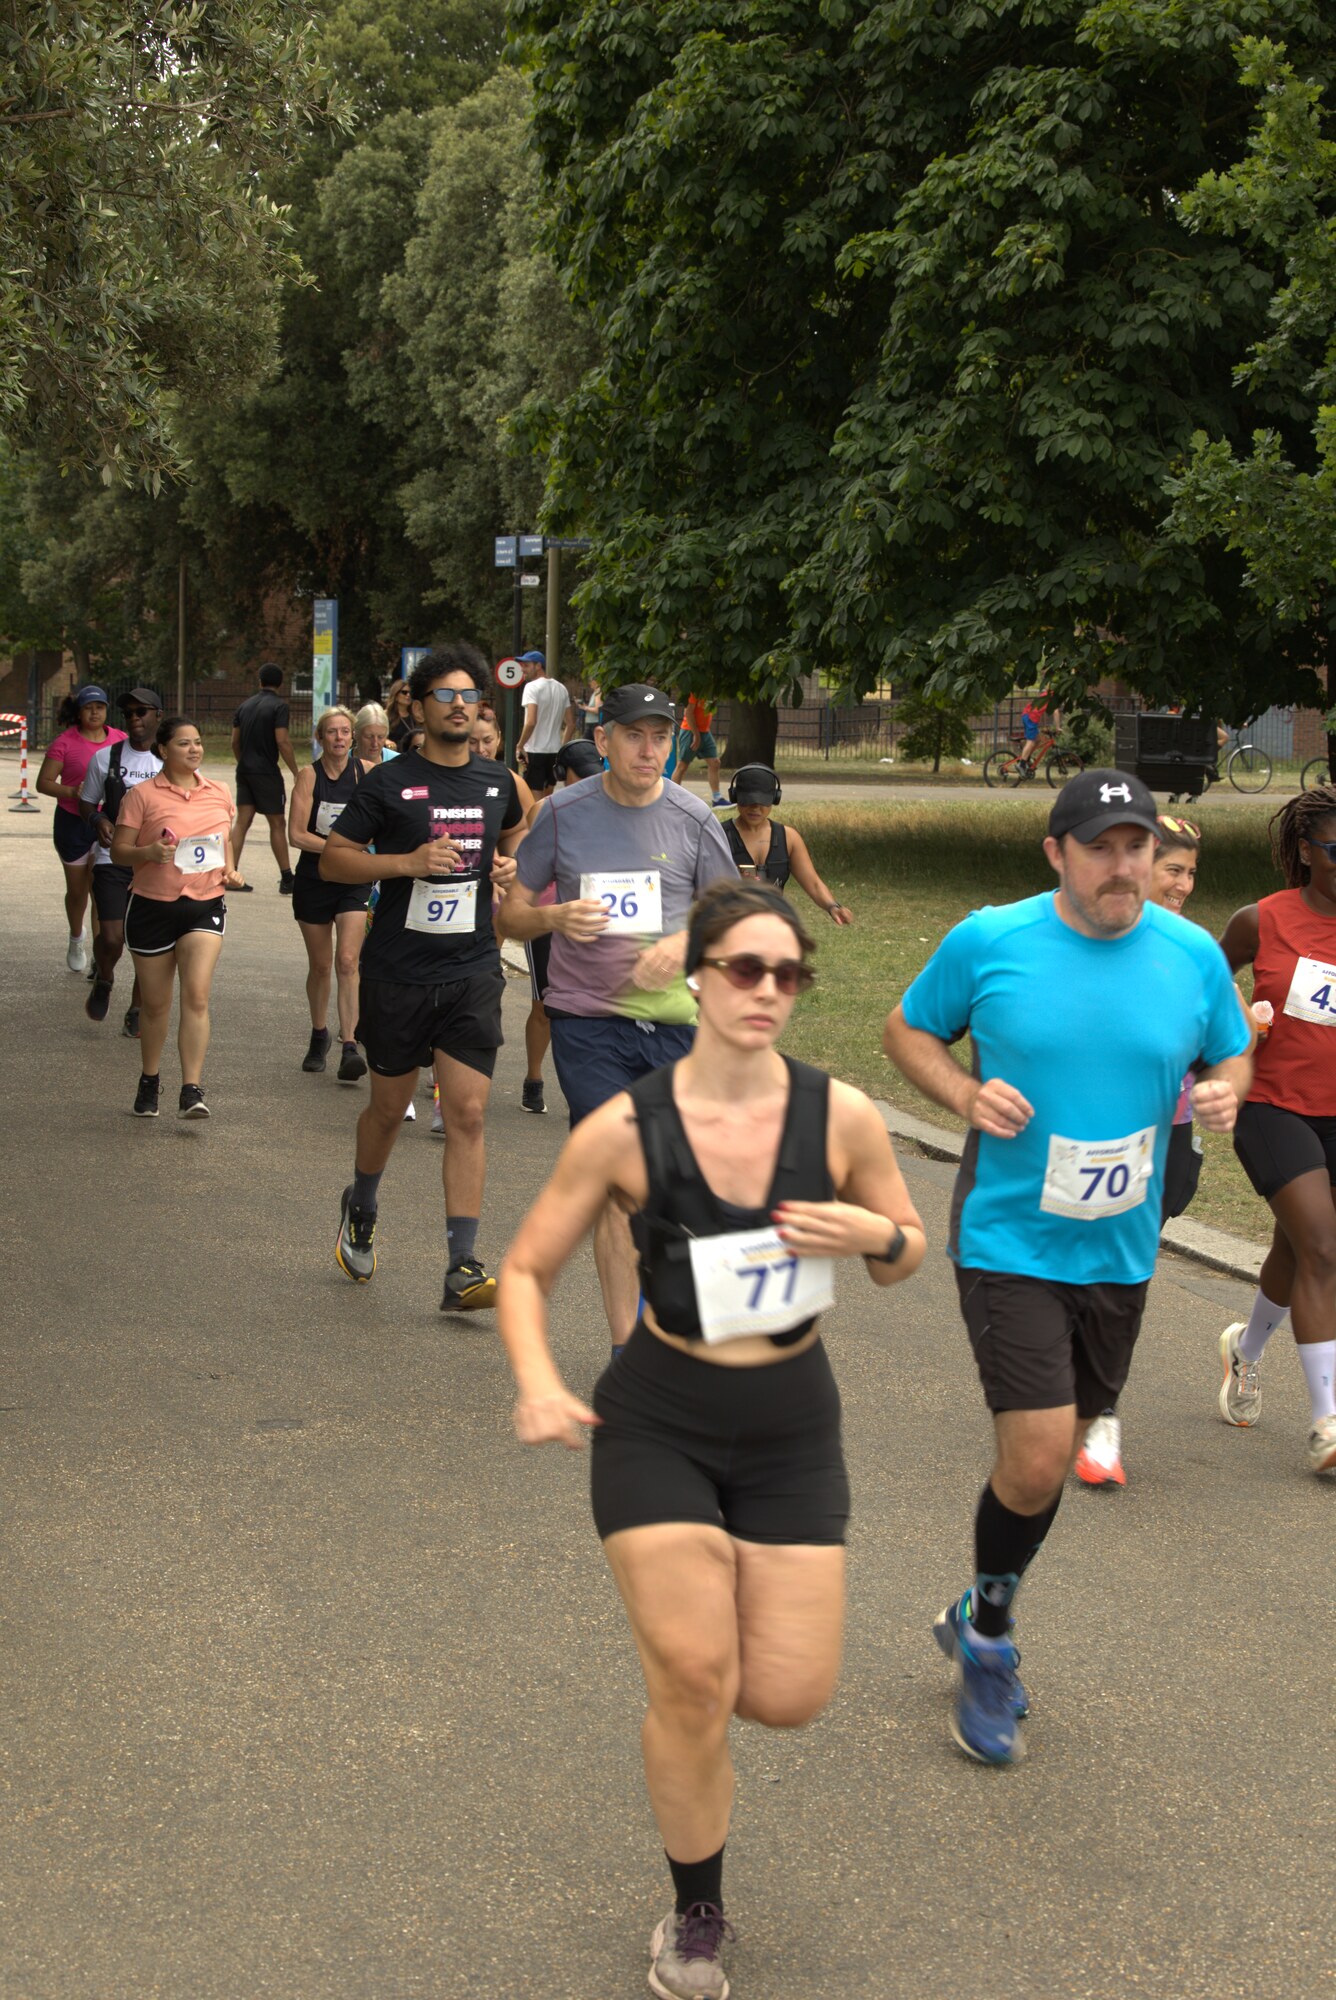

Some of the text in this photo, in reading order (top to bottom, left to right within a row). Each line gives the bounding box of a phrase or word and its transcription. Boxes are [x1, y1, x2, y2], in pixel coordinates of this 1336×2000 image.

[506, 667, 515, 679] 5
[129, 771, 158, 779] FlickF
[433, 808, 483, 819] FINISHER
[194, 846, 205, 864] 9
[427, 899, 459, 922] 97
[600, 891, 638, 918] 26
[1079, 1163, 1129, 1201] 70
[735, 1256, 798, 1310] 77
